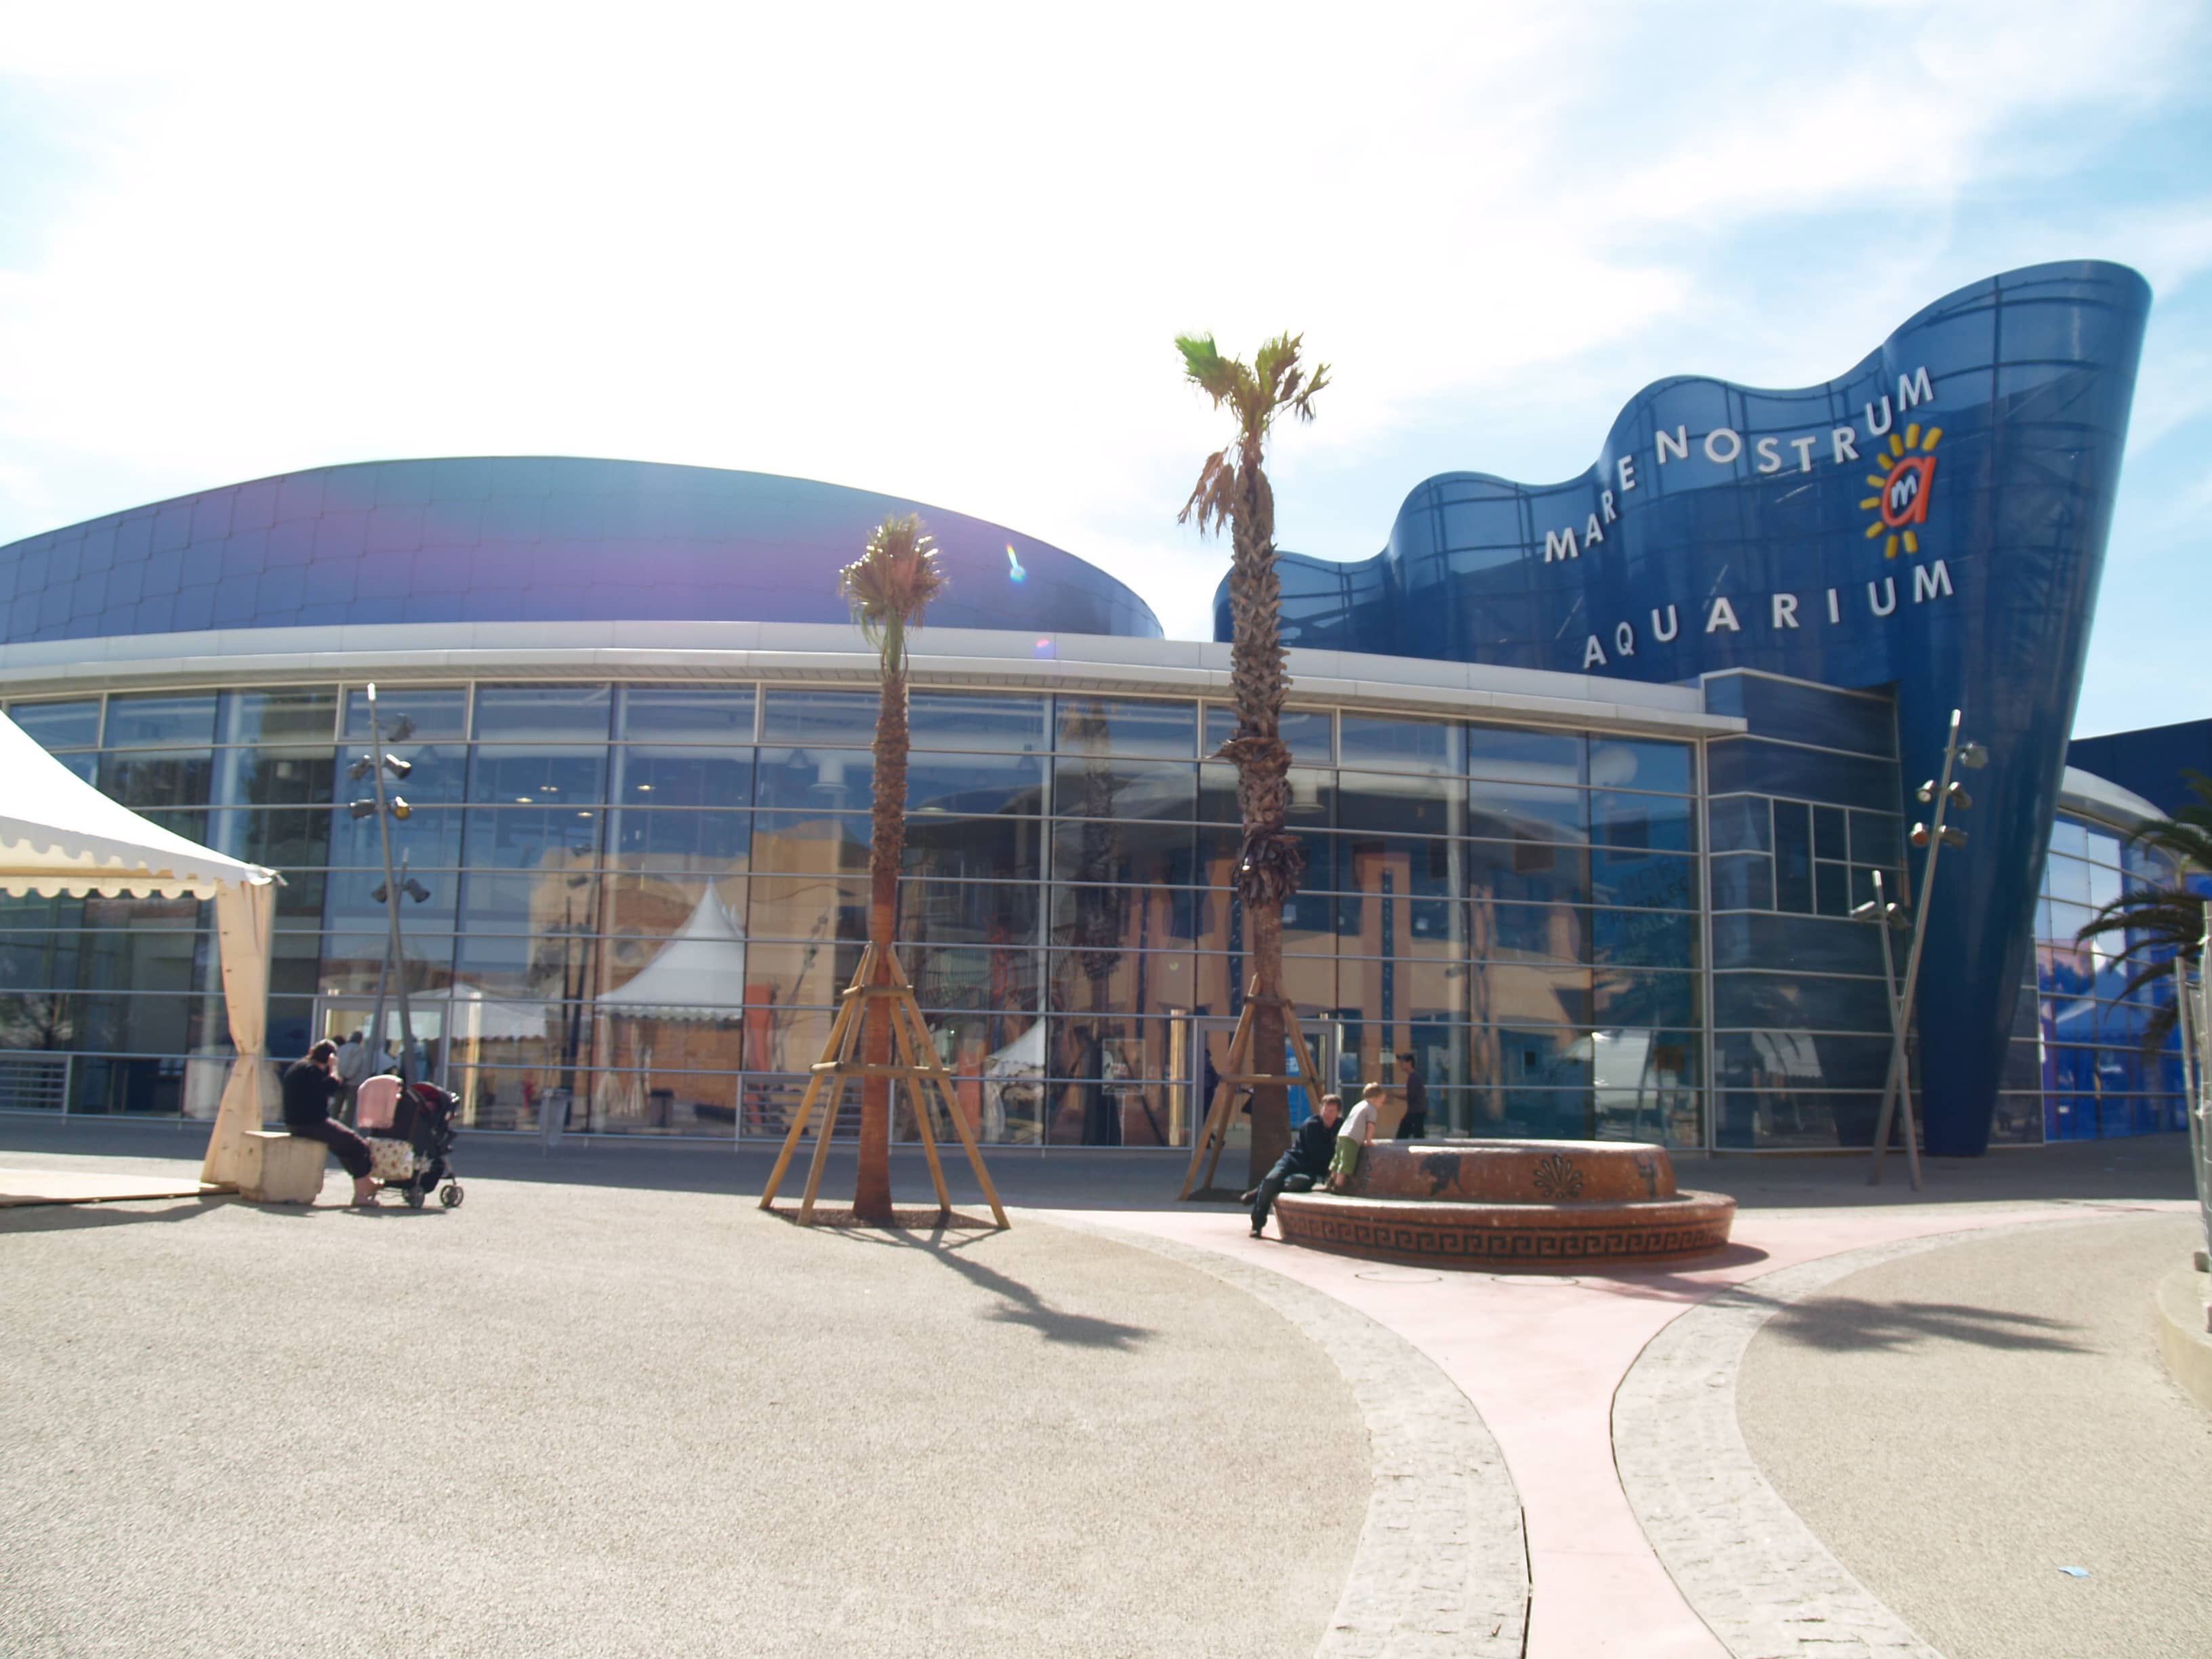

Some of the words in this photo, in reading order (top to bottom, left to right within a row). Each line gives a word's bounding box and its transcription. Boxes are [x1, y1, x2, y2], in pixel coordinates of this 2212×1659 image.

[1544, 455, 1635, 562] MARE
[1656, 367, 1934, 473] NOSTRUM
[1584, 560, 1953, 669] AQUARIUM
